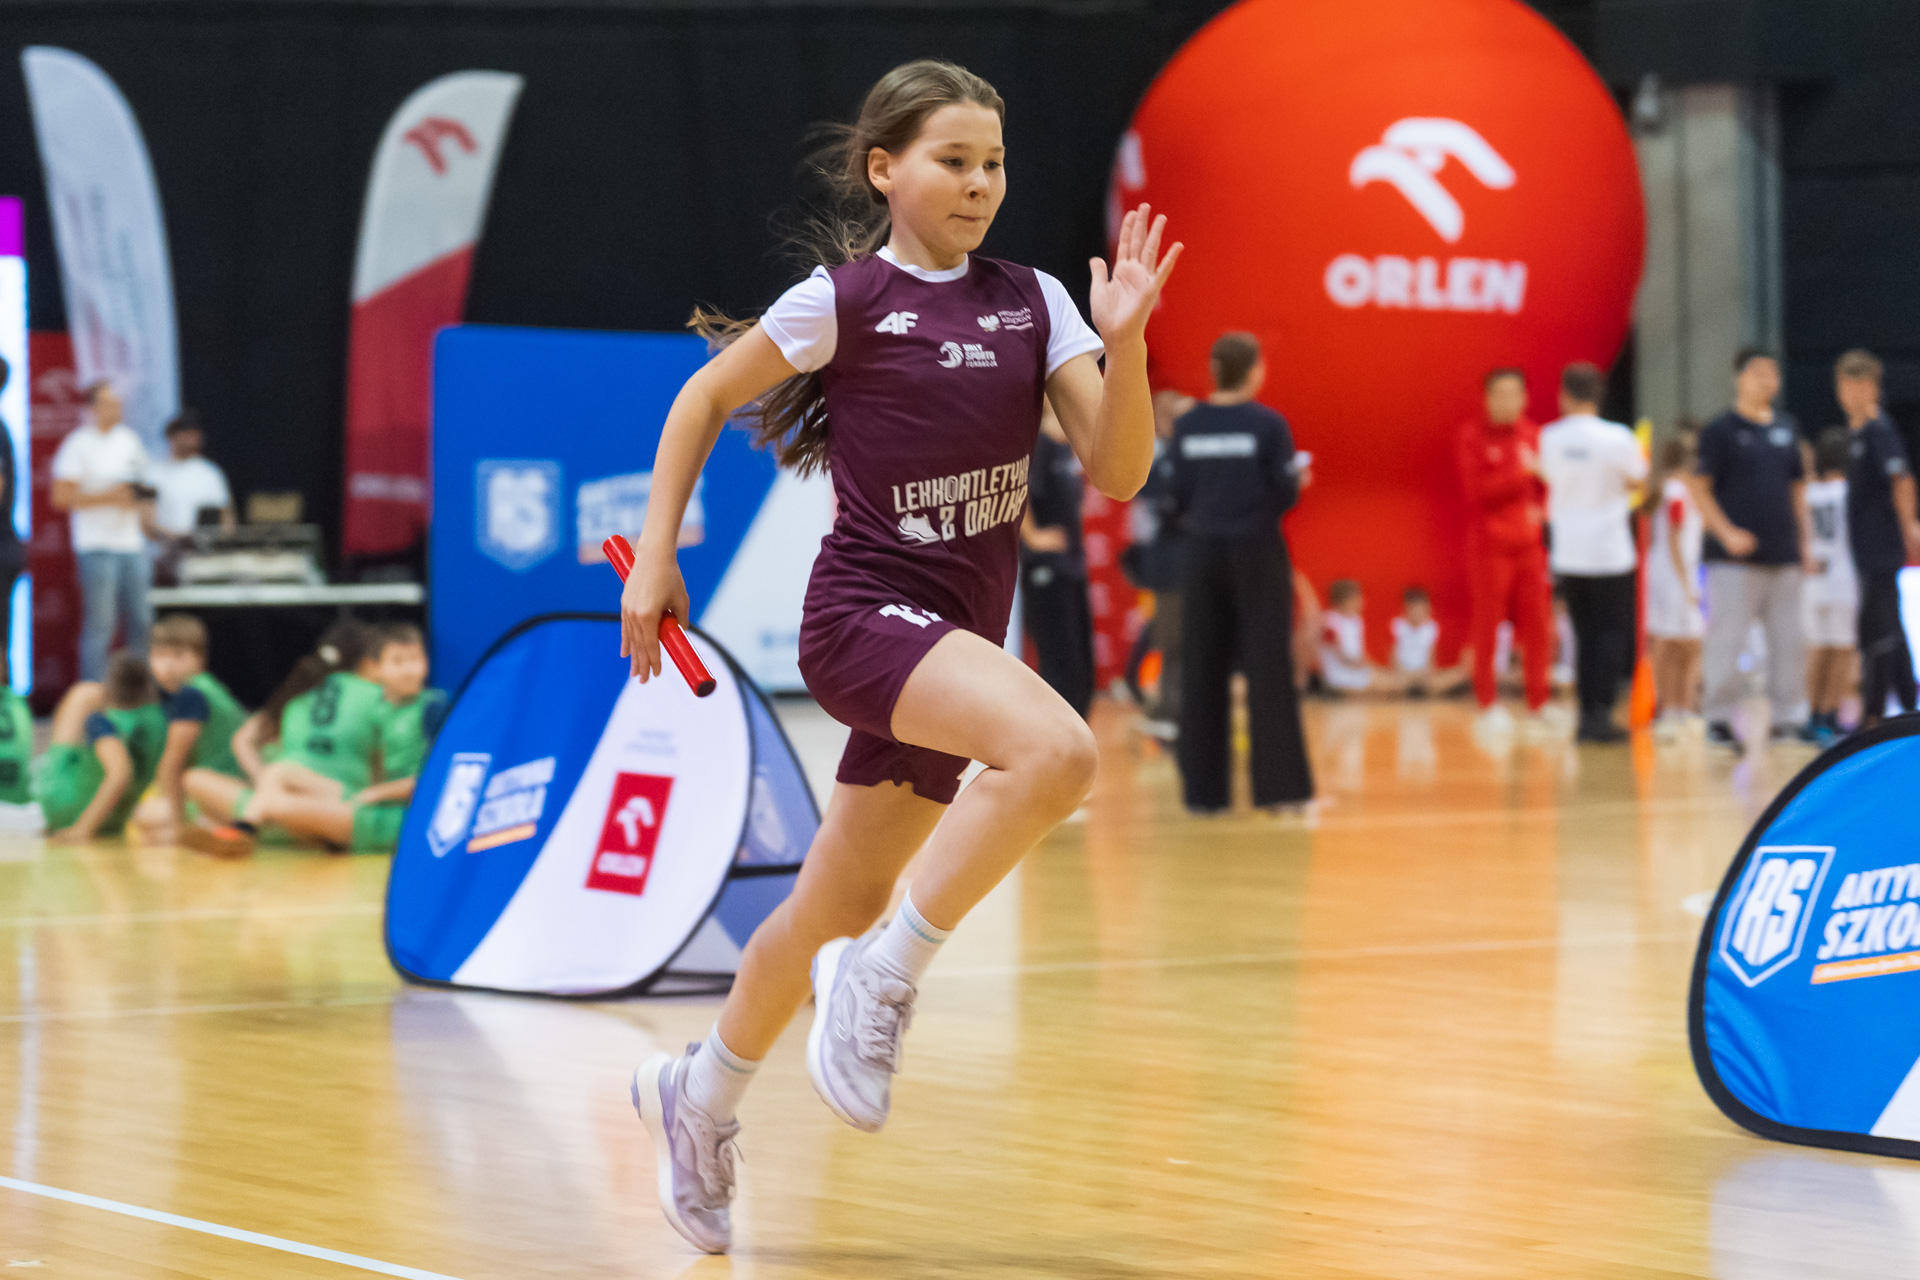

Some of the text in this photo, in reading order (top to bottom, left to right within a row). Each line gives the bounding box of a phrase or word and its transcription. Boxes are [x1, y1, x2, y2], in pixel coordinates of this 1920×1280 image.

[1324, 254, 1528, 314] ORLEN
[875, 311, 919, 335] 4F
[1731, 858, 1817, 966] AS
